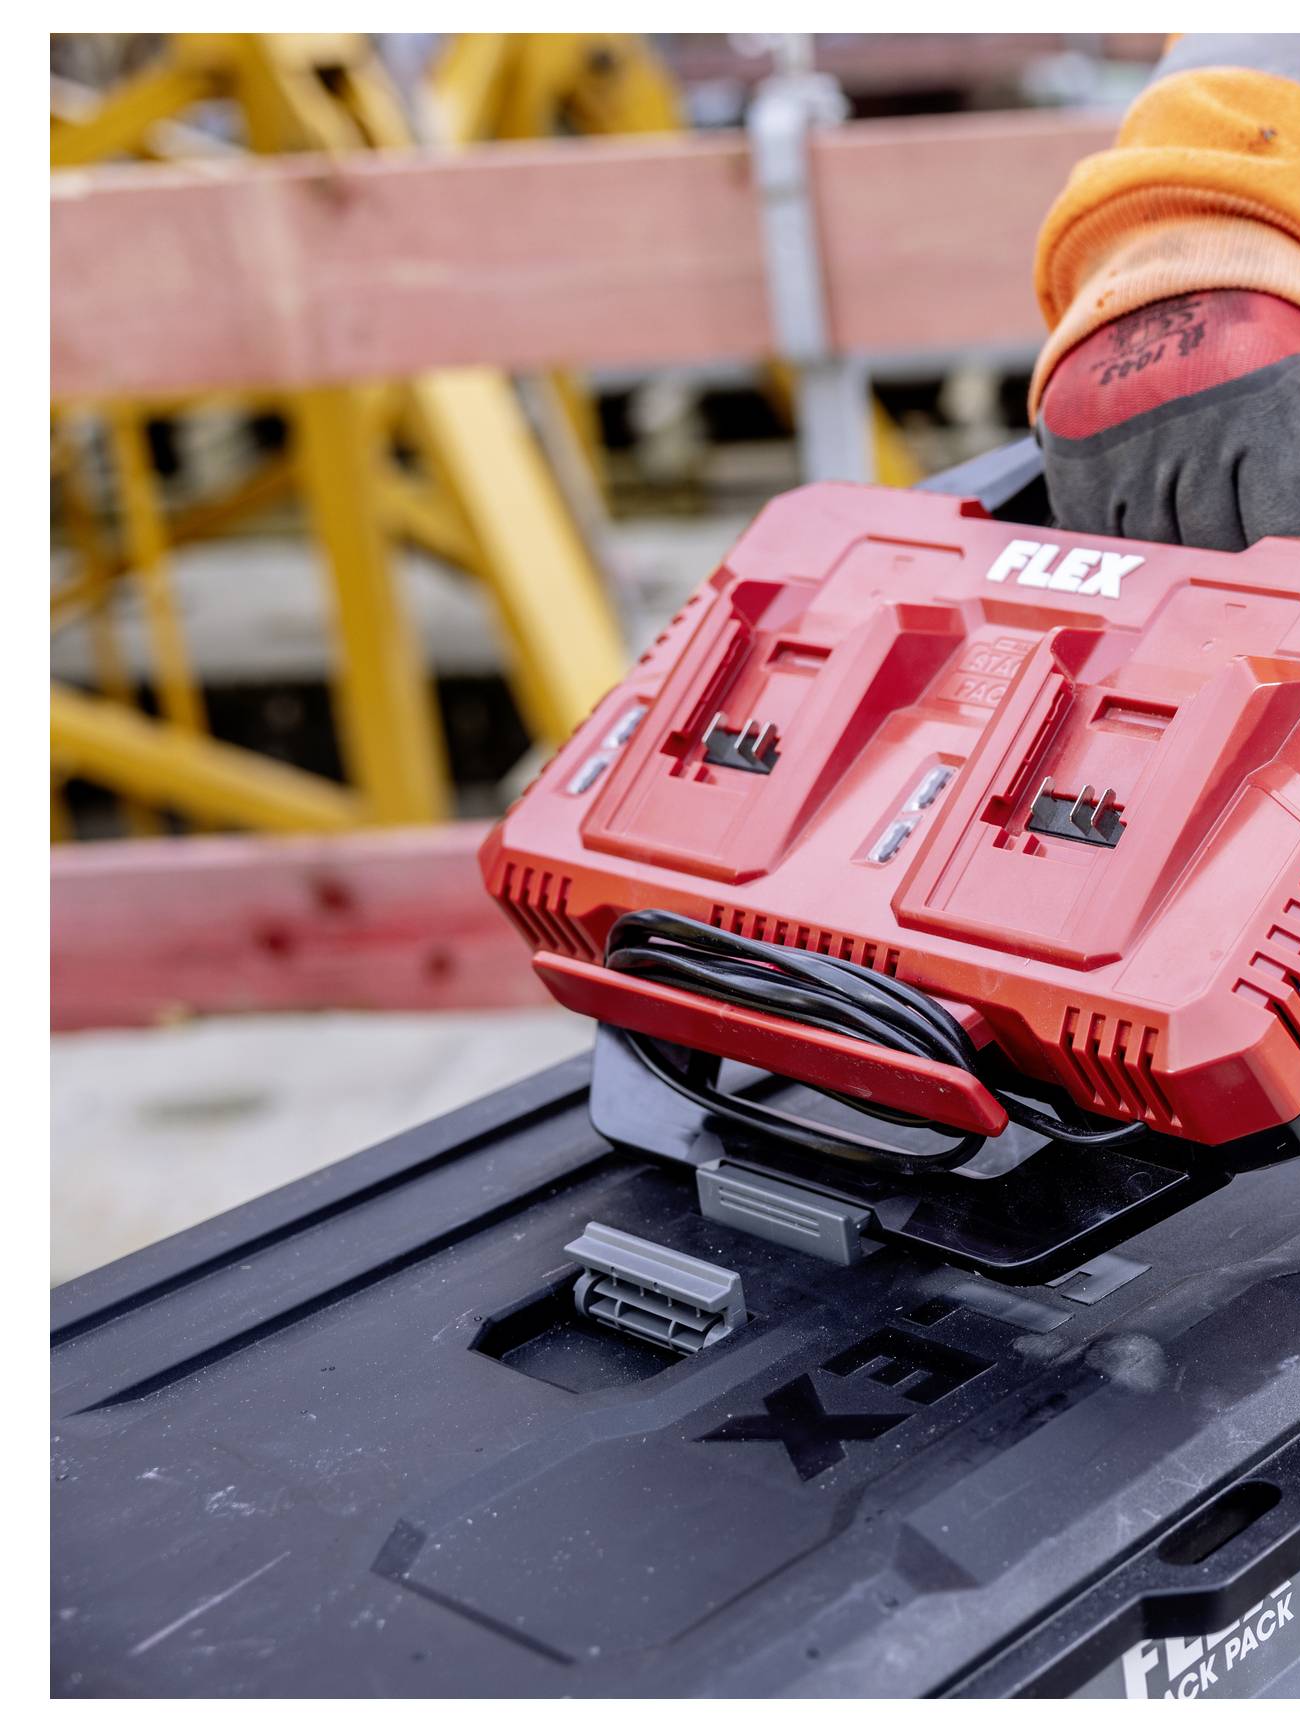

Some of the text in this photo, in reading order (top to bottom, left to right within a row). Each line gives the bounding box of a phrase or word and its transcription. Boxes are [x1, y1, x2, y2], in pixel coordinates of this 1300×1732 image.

[985, 539, 1147, 599] FLEX
[969, 650, 1022, 676] STA
[954, 678, 1009, 702] PAC
[1224, 1591, 1295, 1672] PACK
